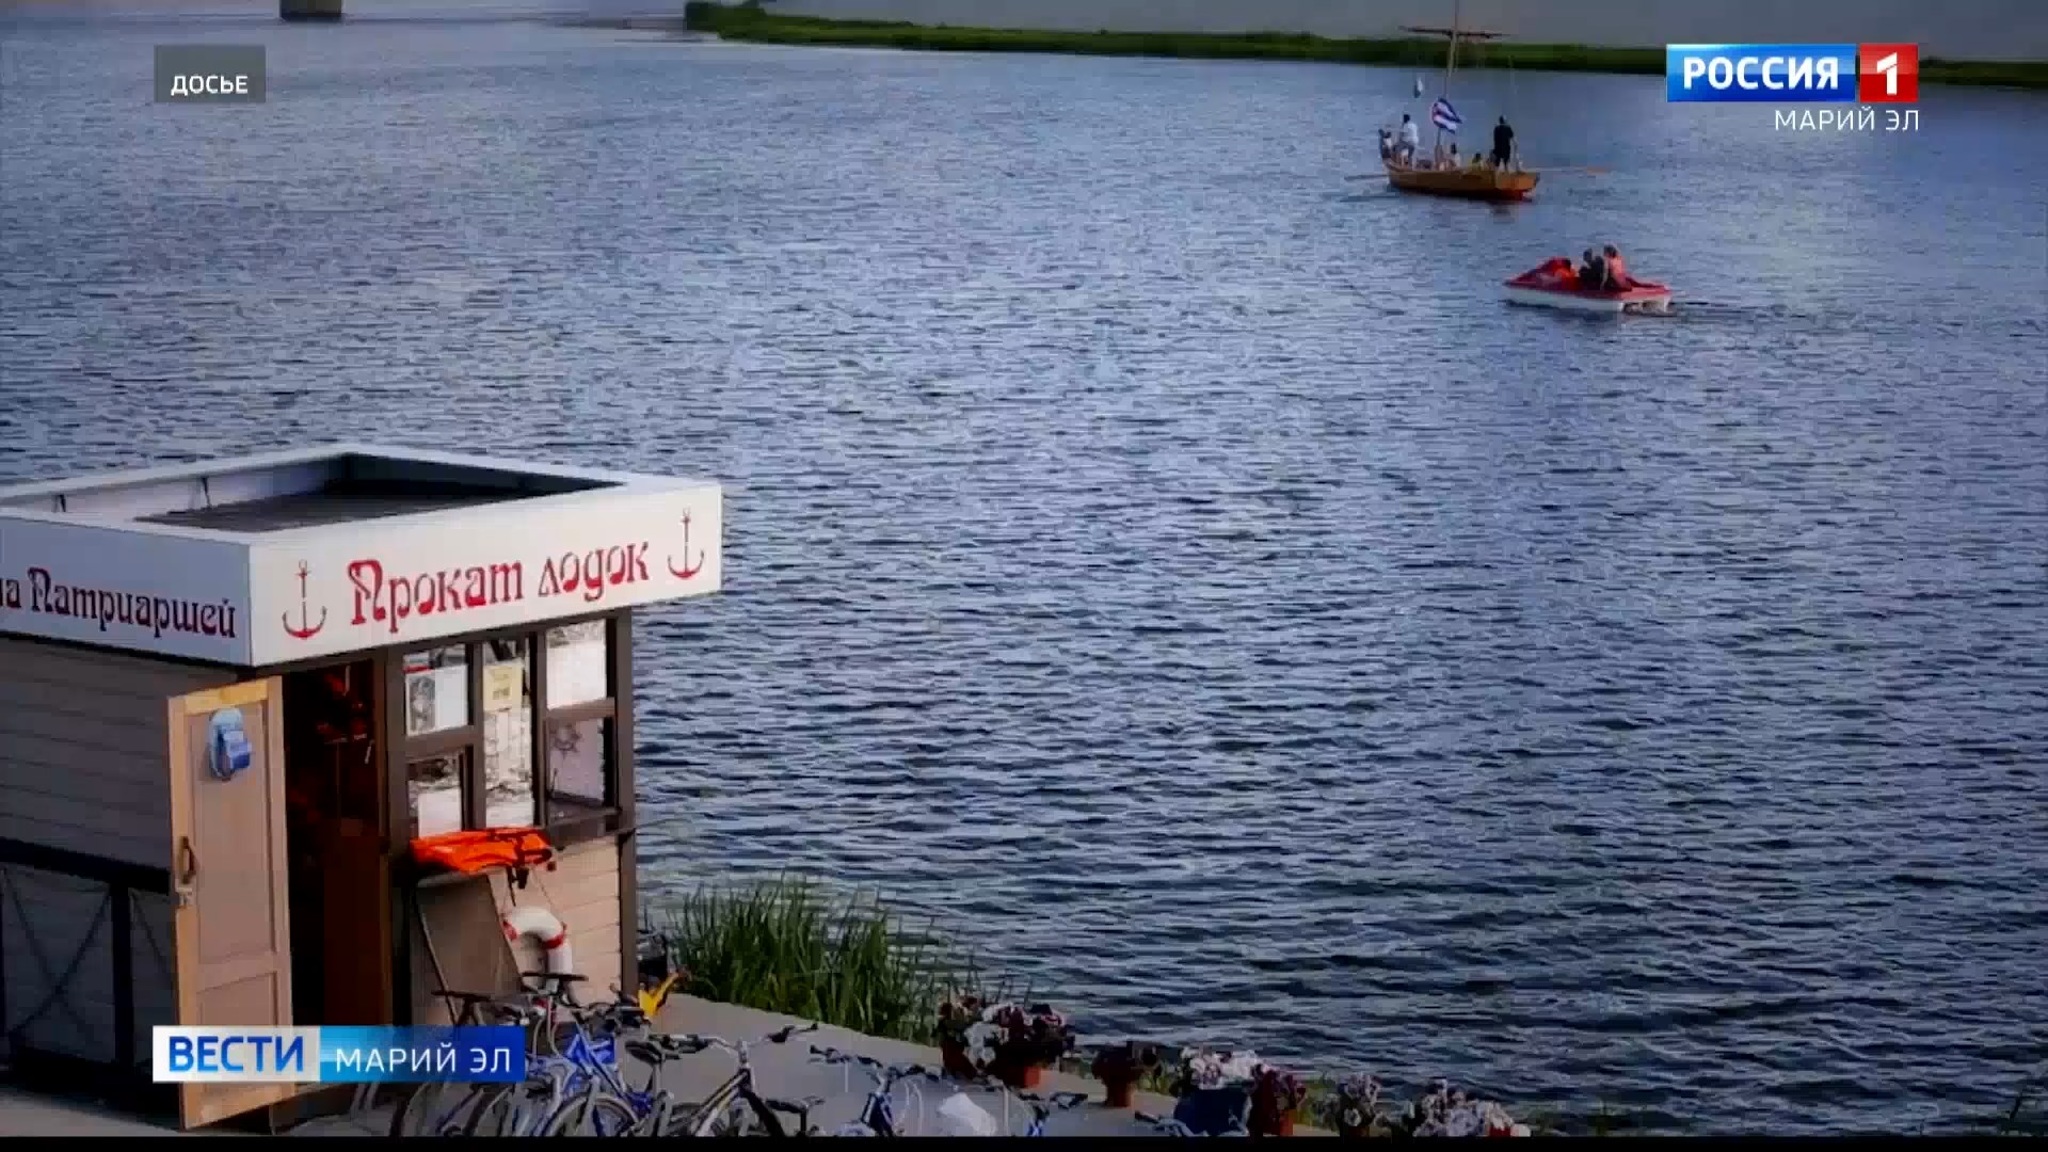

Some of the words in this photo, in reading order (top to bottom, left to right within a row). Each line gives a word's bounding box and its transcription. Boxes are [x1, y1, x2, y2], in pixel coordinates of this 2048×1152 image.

[27, 566, 237, 639] Патриаршей
[347, 558, 524, 634] Прокат
[538, 541, 650, 602] лодок
